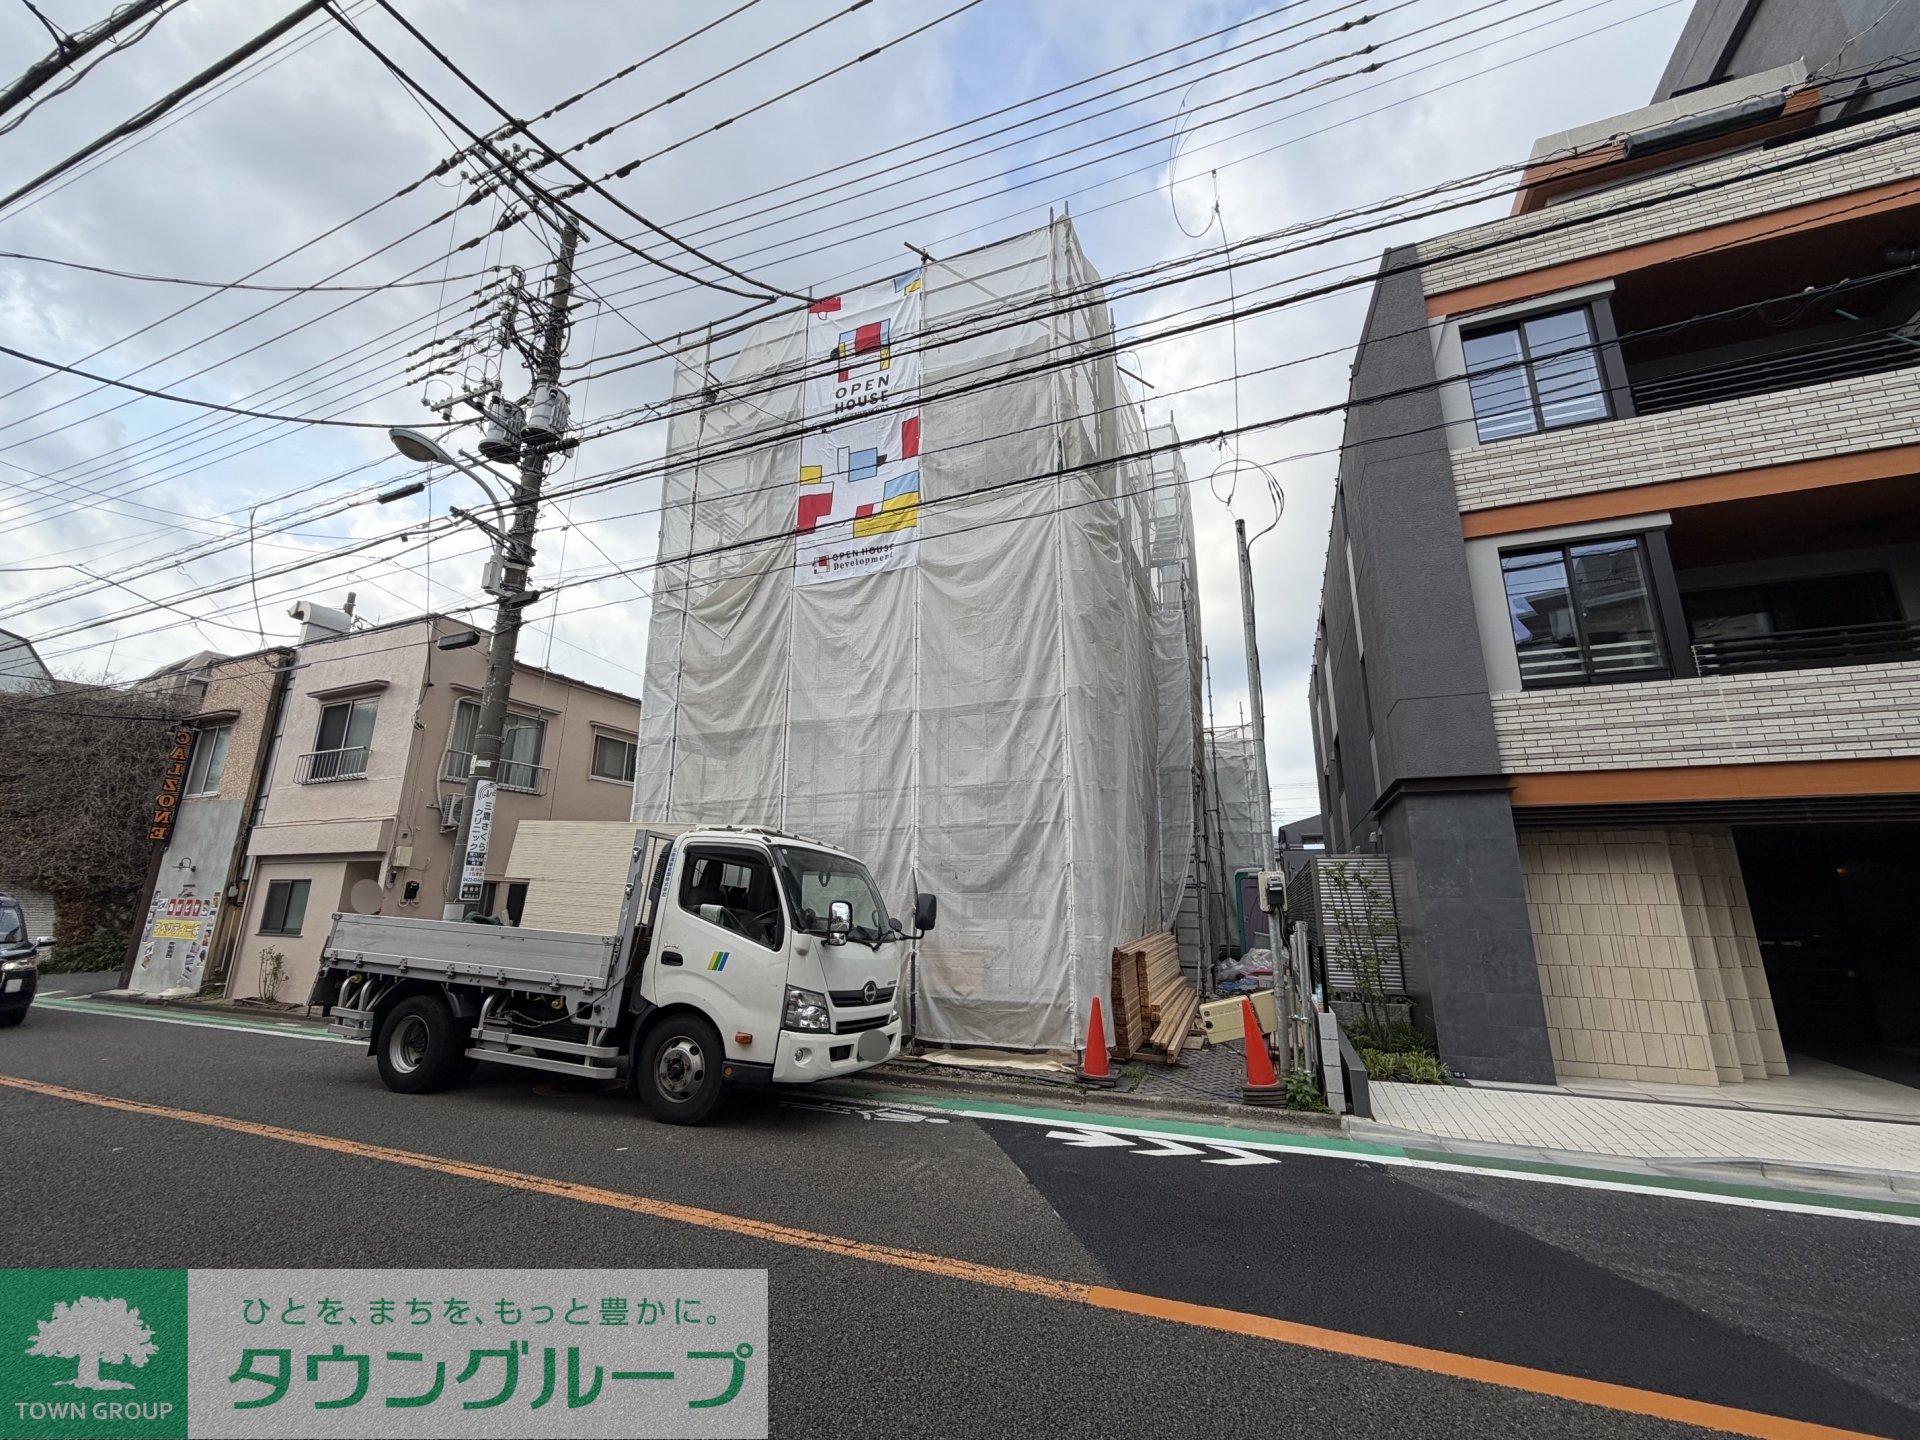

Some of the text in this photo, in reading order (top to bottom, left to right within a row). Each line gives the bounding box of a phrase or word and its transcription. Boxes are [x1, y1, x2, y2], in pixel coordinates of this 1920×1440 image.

[835, 374, 890, 399] OPEN
[834, 389, 889, 415] HOUSE
[832, 549, 859, 562] OPEN
[833, 551, 894, 571] Development
[469, 808, 484, 851] クリニック
[478, 801, 493, 852] 三鷹さくら
